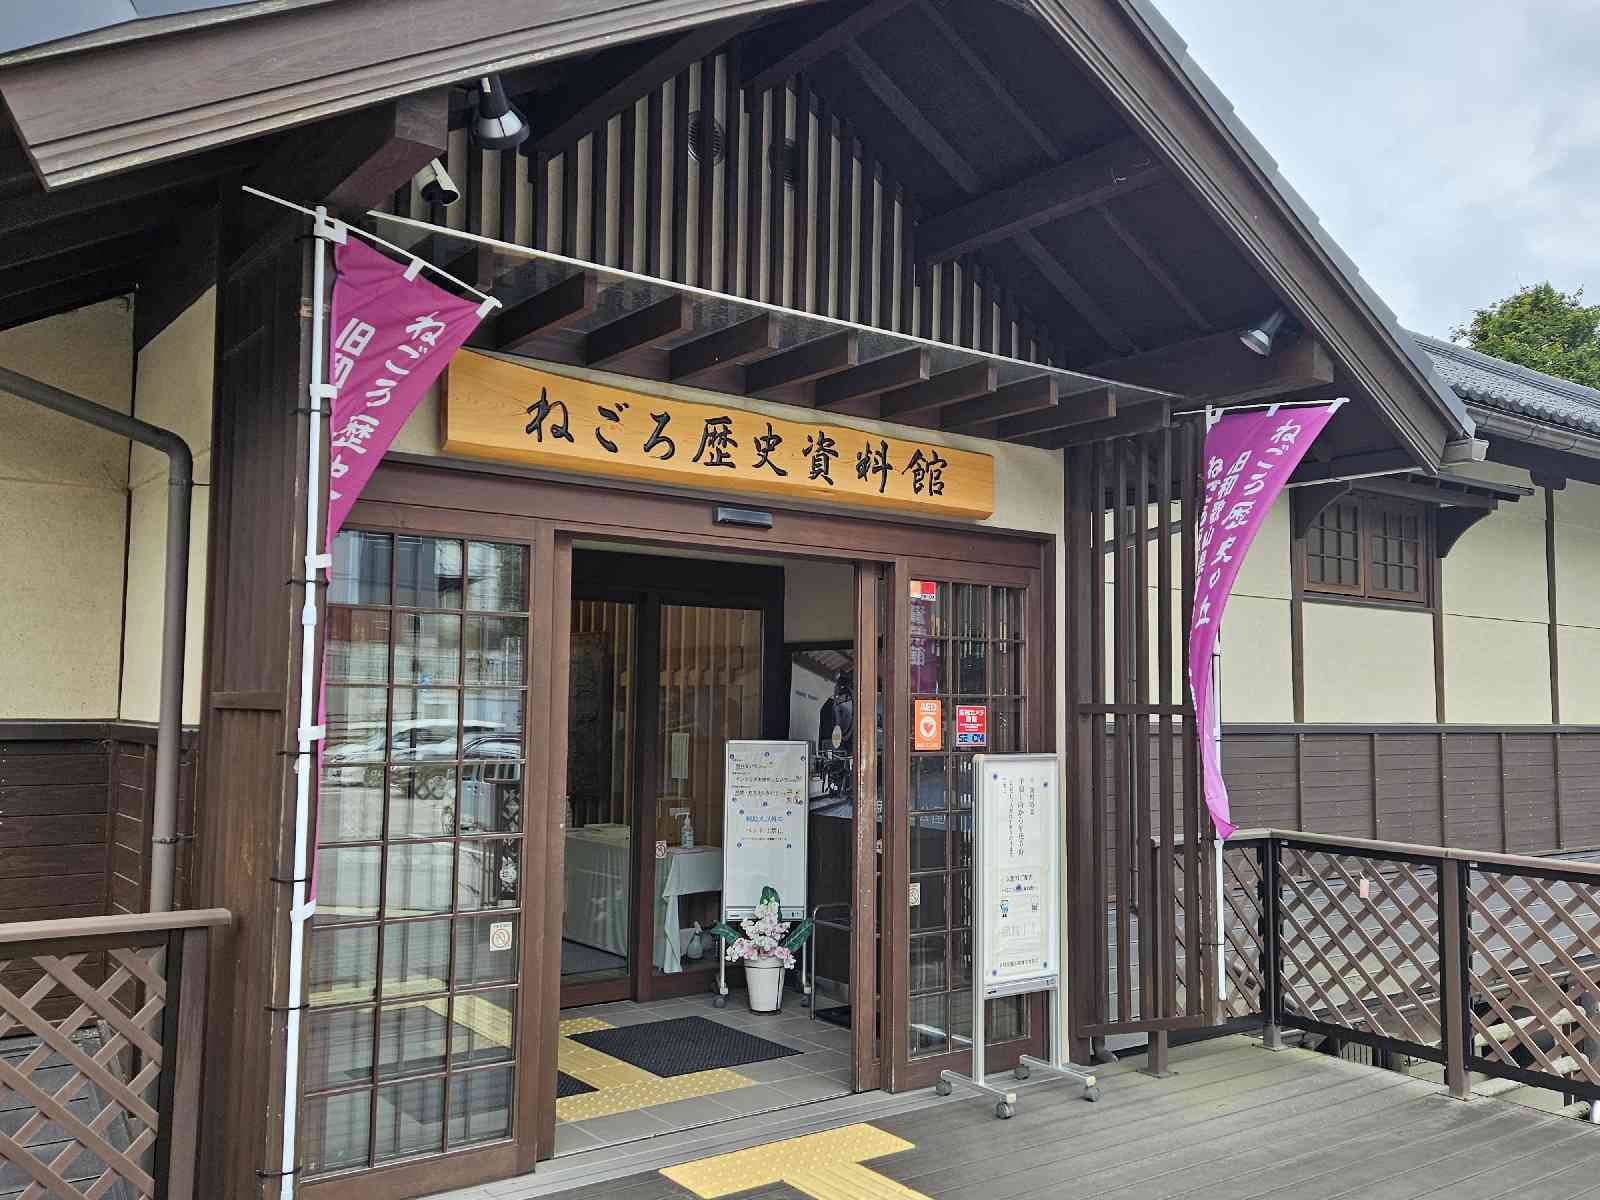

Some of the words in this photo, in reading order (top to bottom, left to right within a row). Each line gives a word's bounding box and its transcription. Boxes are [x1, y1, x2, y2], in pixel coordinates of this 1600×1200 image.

[525, 386, 949, 497] ねごろ歴史資料館
[1196, 418, 1302, 628] ねごろ歴史の丘
